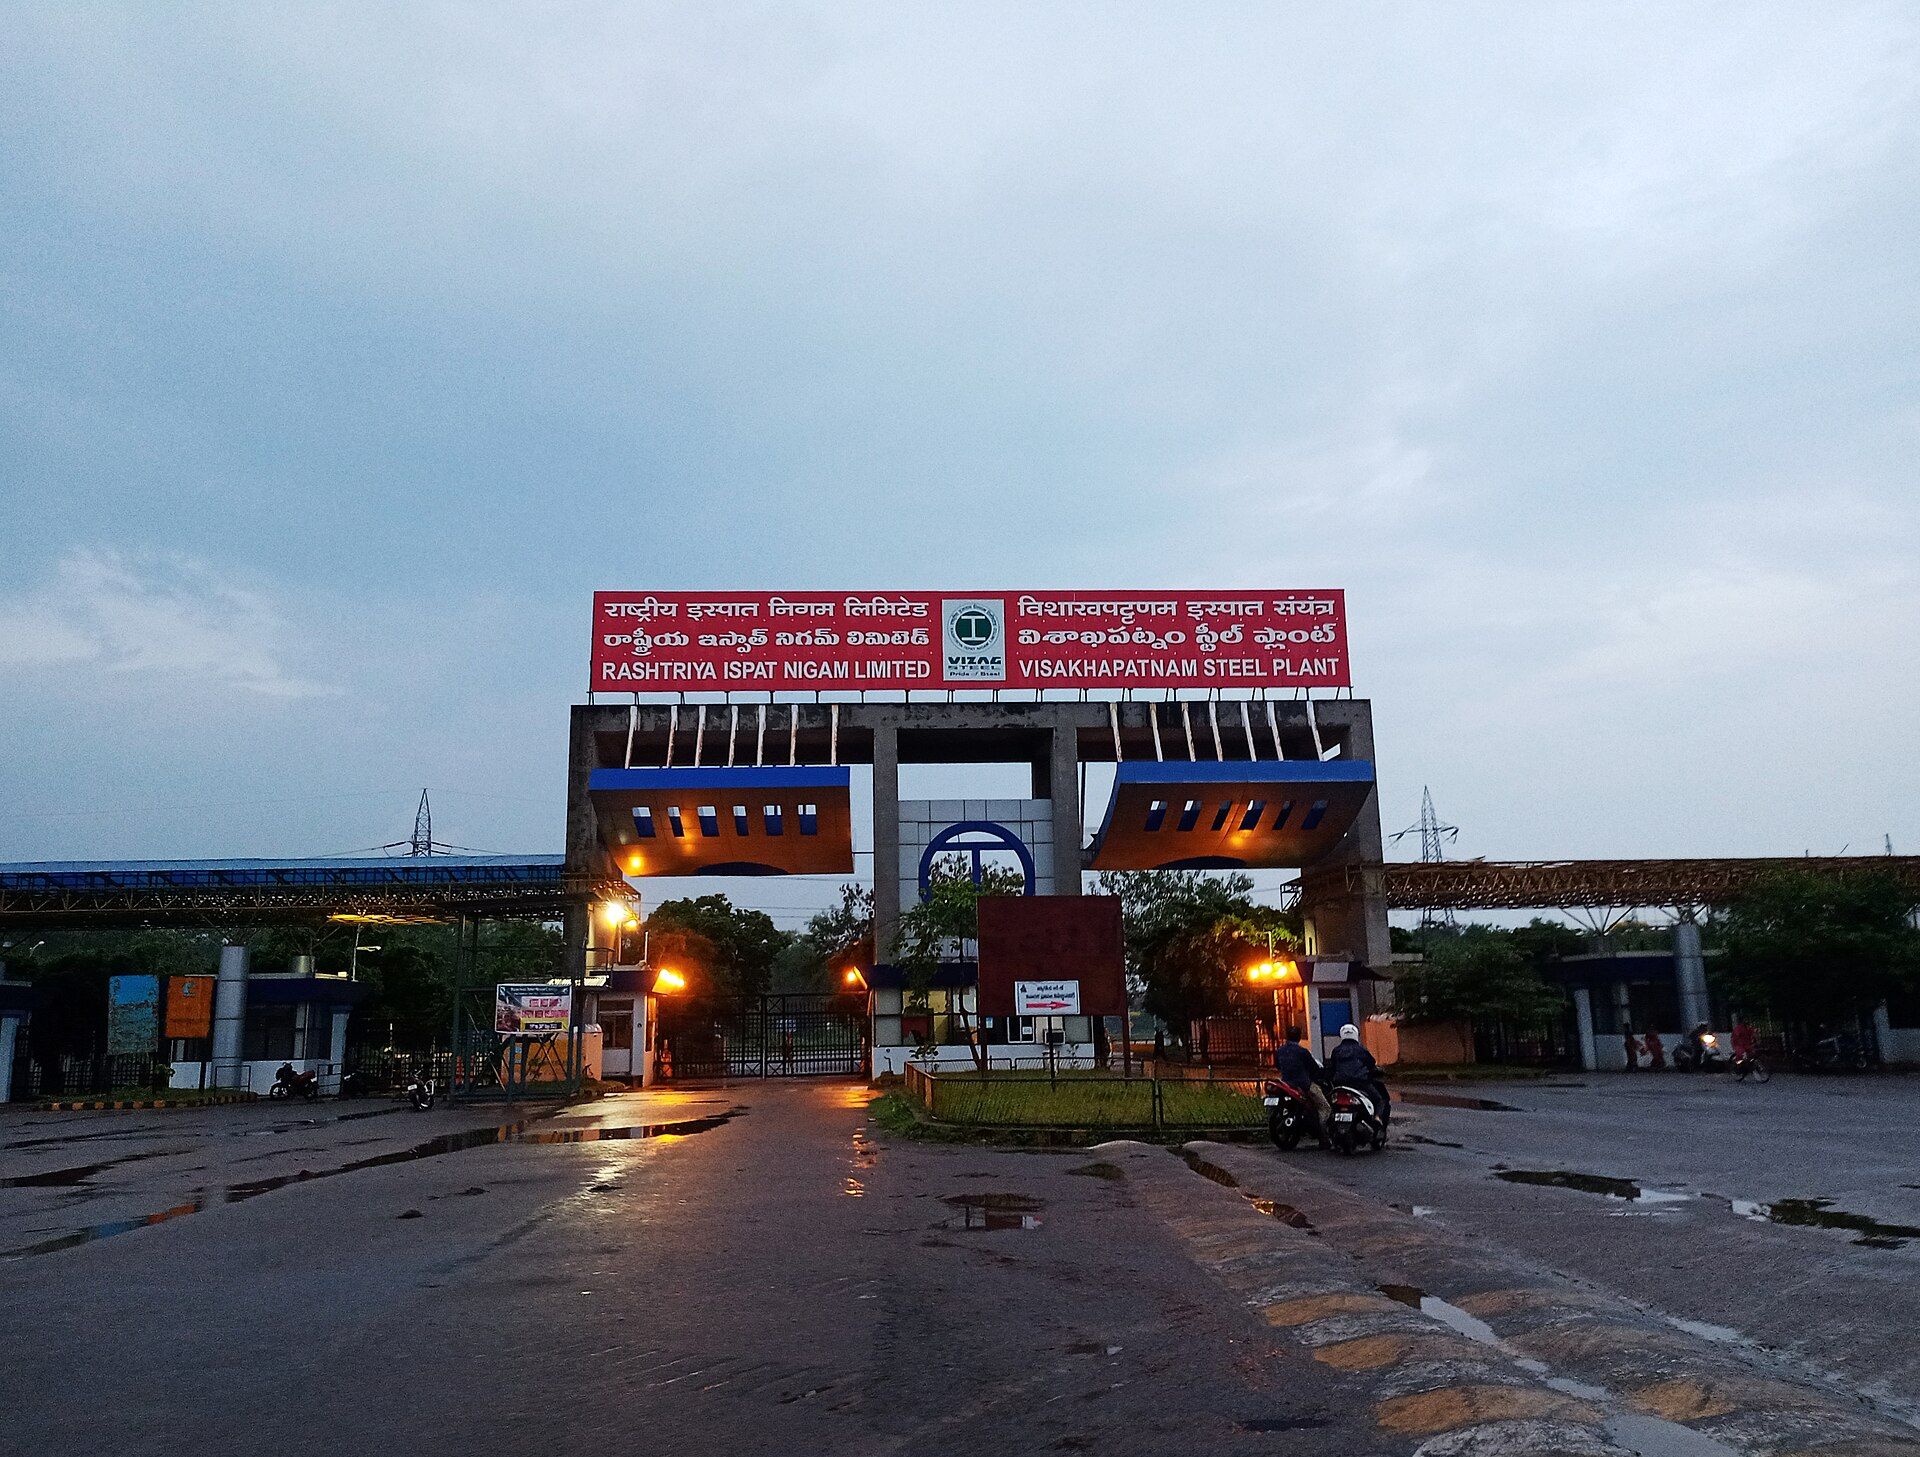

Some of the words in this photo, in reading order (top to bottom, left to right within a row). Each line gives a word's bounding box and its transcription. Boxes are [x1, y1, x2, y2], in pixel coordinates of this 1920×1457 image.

[604, 596, 678, 622] राष्ट्रीय
[686, 602, 759, 621] इस्पात
[768, 596, 836, 617] निगम
[843, 596, 929, 617] लिमिटेड
[1185, 600, 1264, 621] इस्पात
[1272, 595, 1335, 616] संयंत्र
[698, 628, 769, 653] ఇస్పాత్
[775, 628, 840, 646] నిగమ్
[847, 628, 930, 646] లిమిటెడ్
[1195, 623, 1245, 652] స్టీల్
[1252, 623, 1337, 650] ప్లాంట్
[602, 660, 717, 681] RASHTRIYA
[723, 660, 777, 680] ISPAT
[783, 660, 849, 680] NIGAM
[854, 660, 931, 680] LIMITED
[948, 656, 1001, 665] VIZAG
[1018, 658, 1198, 678] VISAKHAPATNAM
[1203, 658, 1268, 677] STEEL
[1272, 657, 1340, 677] PLANT
